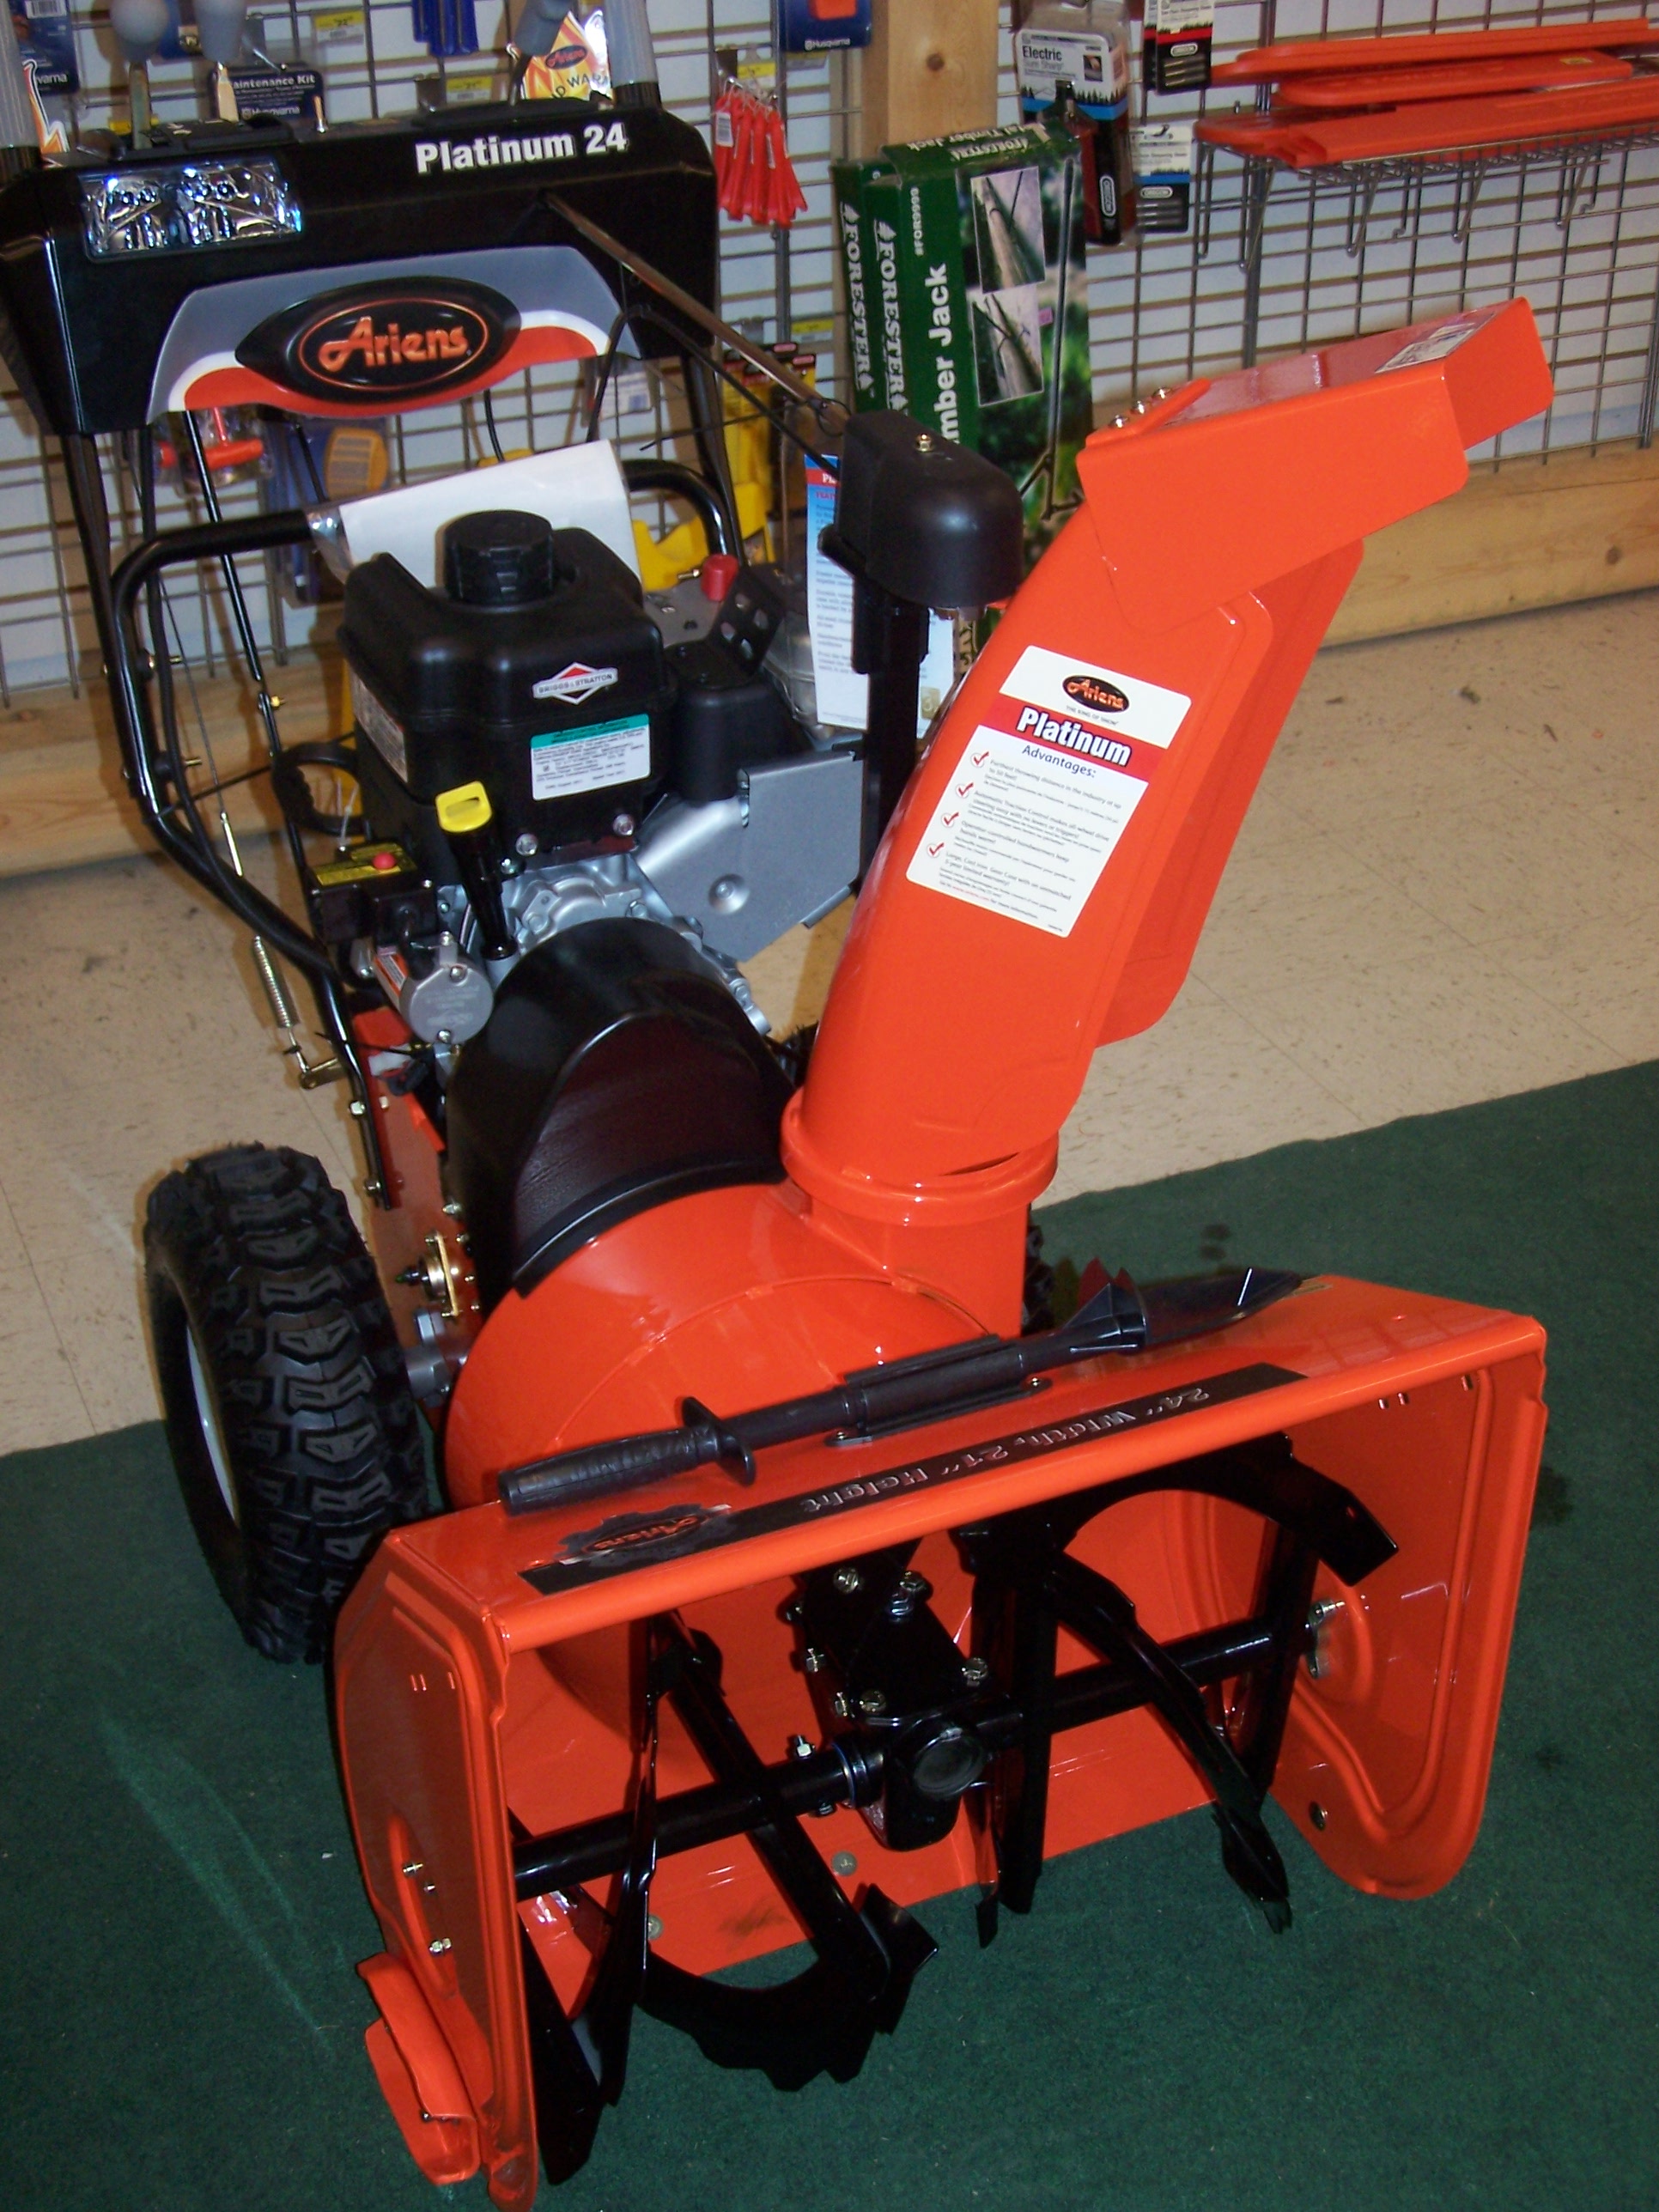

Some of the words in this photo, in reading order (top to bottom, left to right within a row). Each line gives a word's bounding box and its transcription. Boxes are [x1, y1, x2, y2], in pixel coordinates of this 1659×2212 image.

[1022, 46, 1063, 62] Electric
[234, 77, 295, 88] aintenance
[297, 75, 315, 84] Kit
[415, 135, 575, 174] Platinum
[584, 122, 629, 155] 24
[844, 222, 871, 372] FORESTER
[878, 241, 904, 394] FORESTER
[925, 262, 952, 347] Jack
[318, 315, 469, 373] Ariens
[934, 356, 960, 441] mber
[1066, 678, 1124, 709] Ariens
[1016, 705, 1132, 768] Platinum
[1022, 744, 1097, 778] Advantages:
[802, 1468, 928, 1511] Height
[593, 1516, 698, 1550] Ariens
